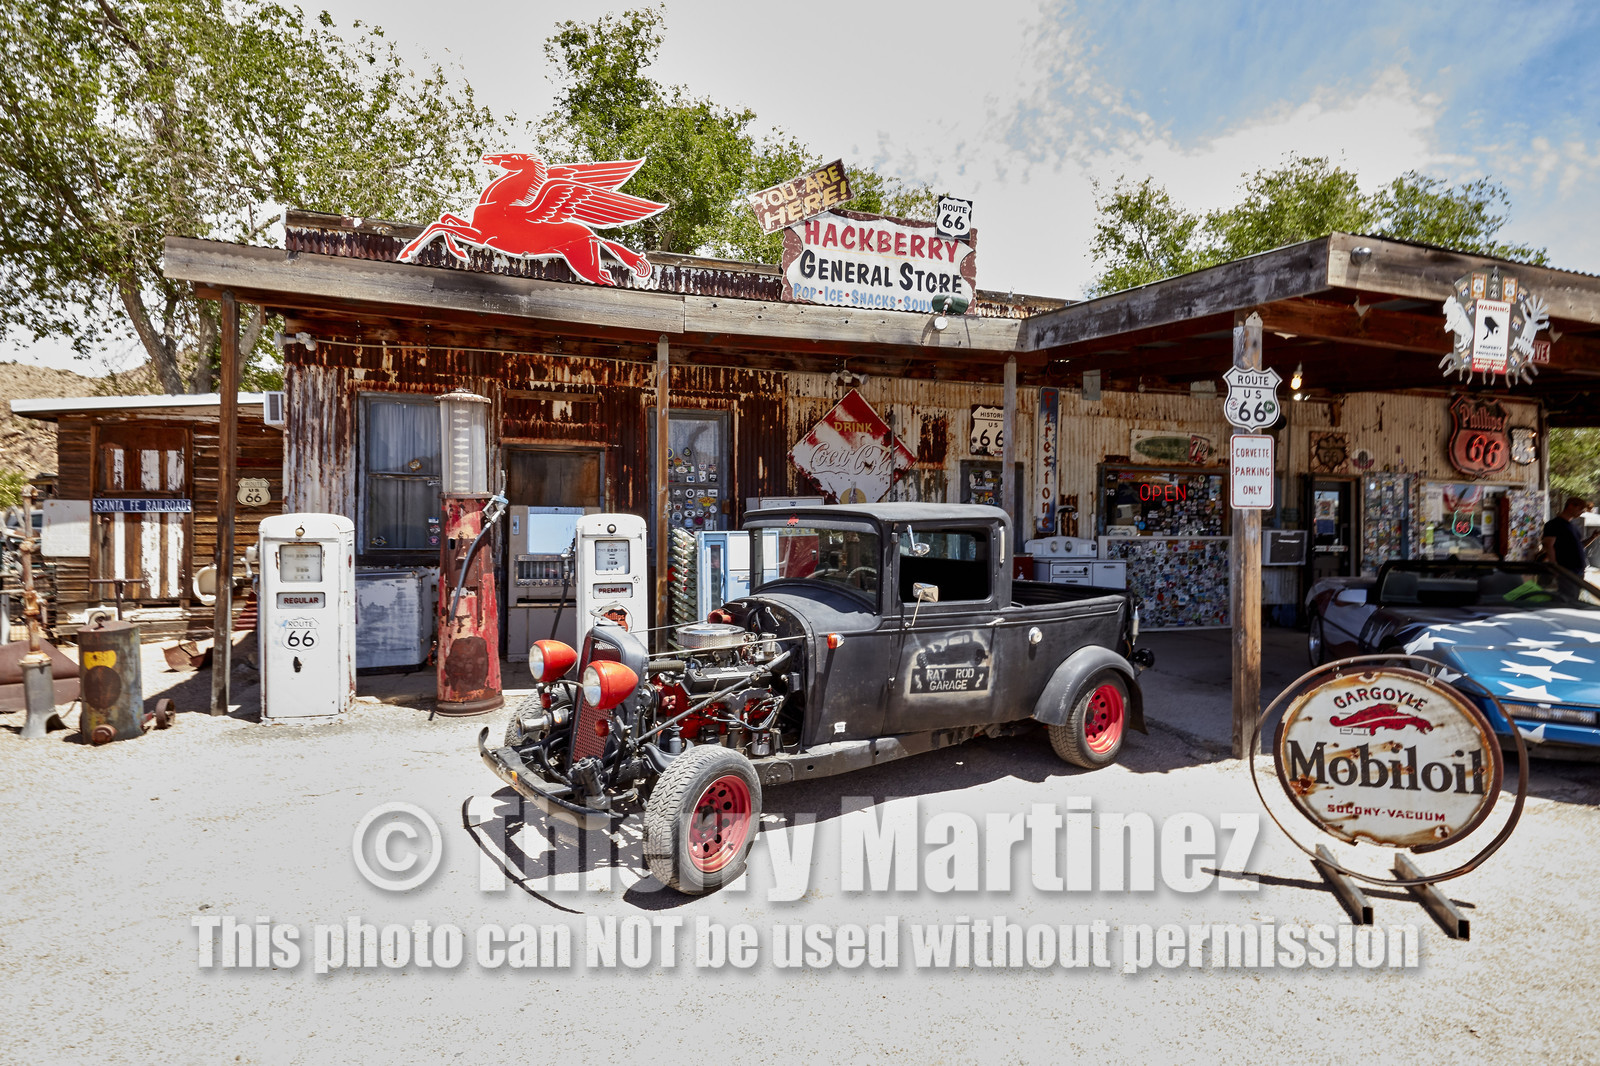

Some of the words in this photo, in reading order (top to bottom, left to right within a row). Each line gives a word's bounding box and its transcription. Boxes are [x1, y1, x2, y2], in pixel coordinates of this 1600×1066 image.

[756, 181, 798, 210] YOU
[805, 165, 842, 193] ARE
[763, 180, 848, 231] HERE!
[942, 203, 968, 214] ROUTE
[942, 213, 965, 231] 66
[804, 220, 959, 263] HACKBERRY
[903, 295, 933, 313] SOUV
[1478, 304, 1509, 313] WARNING
[1237, 375, 1269, 386] ROUTE
[1243, 389, 1262, 399] US
[1238, 401, 1267, 423] 66
[1459, 403, 1503, 432] Phillips
[833, 421, 873, 433] DRINK
[980, 429, 1003, 447] 66
[1235, 448, 1270, 458] CORVETTE
[1466, 434, 1504, 467] 66
[1041, 391, 1056, 528] Firestone
[1235, 467, 1270, 477] PARKING
[245, 493, 262, 503] 66
[1139, 484, 1187, 502] OPEN
[1243, 485, 1262, 495] ONLY
[97, 500, 125, 511] SANTA
[129, 500, 140, 511] FE
[145, 500, 187, 511] RAILROAD
[1456, 521, 1470, 533] 66
[287, 630, 315, 647] 66
[926, 669, 947, 681] RAT
[955, 668, 974, 679] ROD
[929, 680, 968, 691] GARAGE
[1333, 687, 1428, 712] GARGOYLE
[1287, 740, 1486, 795] Mobiloil
[1327, 803, 1446, 822] SOCONY-VACUUM
